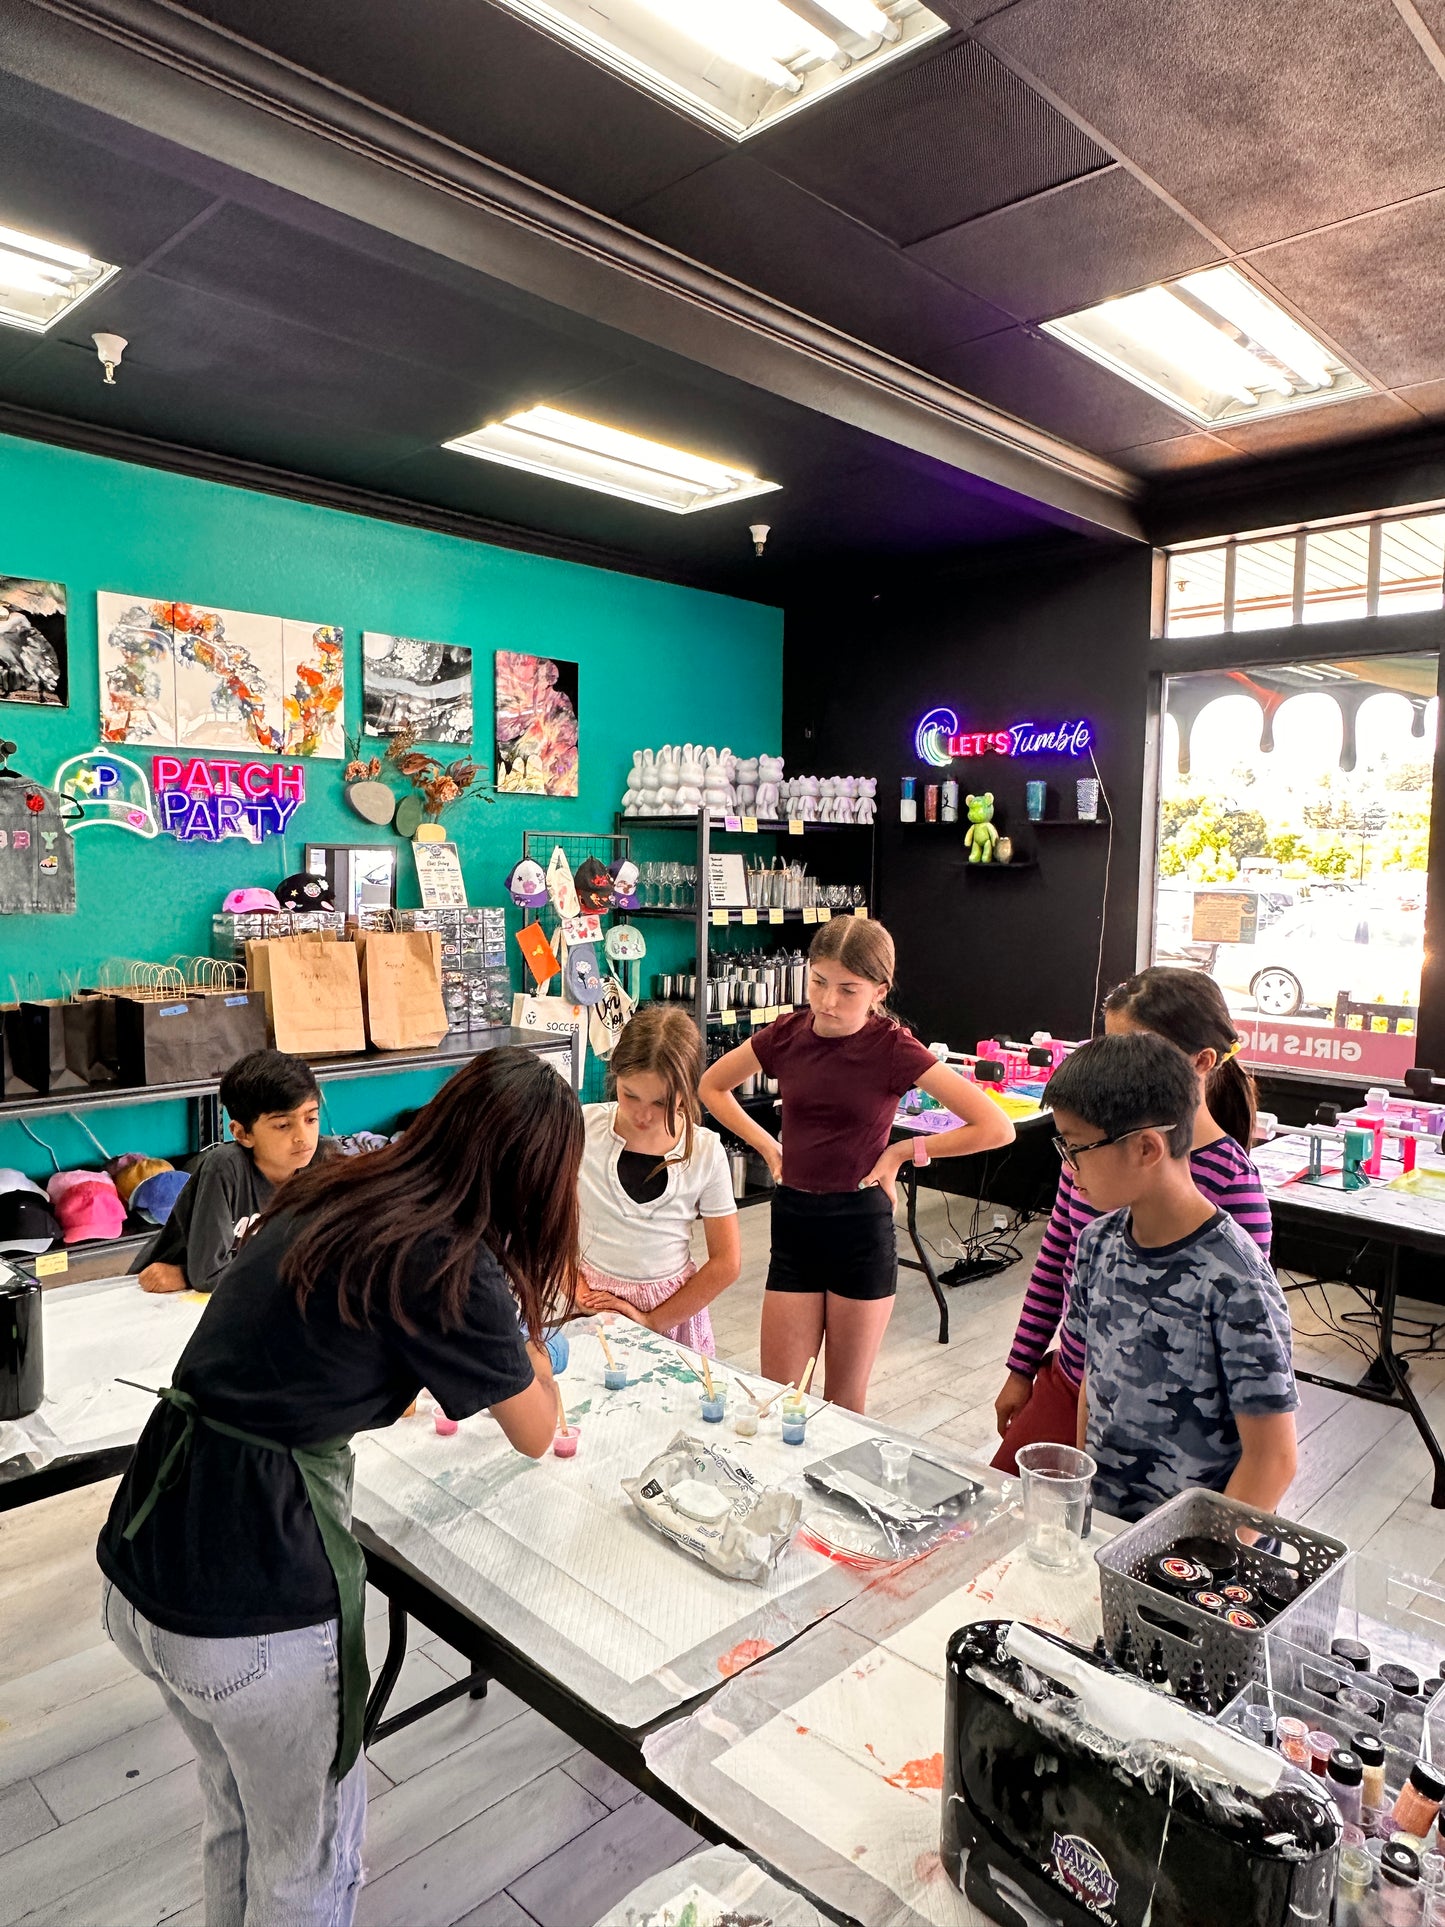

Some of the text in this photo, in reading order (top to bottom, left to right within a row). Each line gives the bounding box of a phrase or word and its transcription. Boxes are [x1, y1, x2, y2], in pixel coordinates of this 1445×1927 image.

[949, 720, 1091, 757] LET'S Tumble
[94, 766, 118, 796] P
[156, 757, 304, 799] PATCH
[162, 790, 296, 842] PARTY
[546, 1022, 580, 1032] SOCCER
[1051, 1832, 1119, 1906] HAWAII
